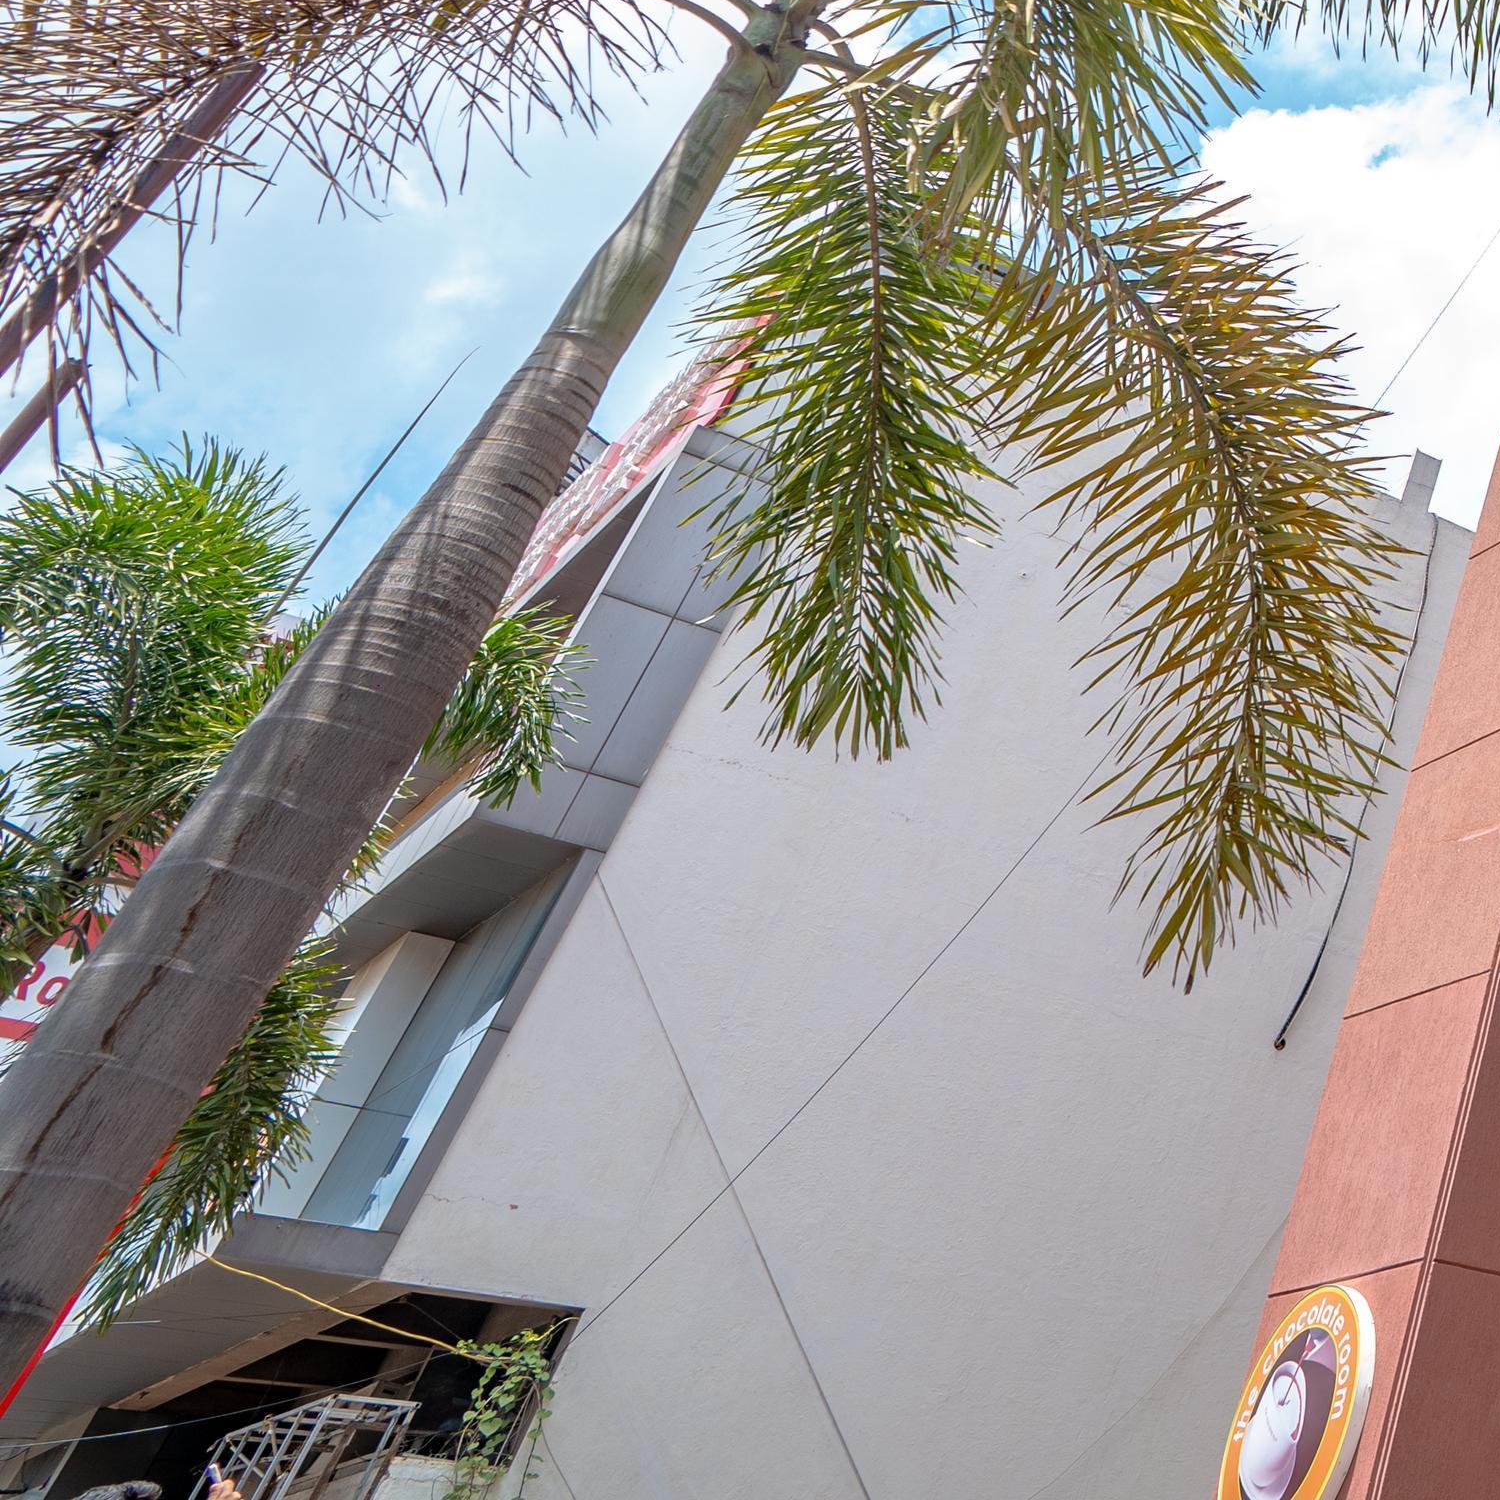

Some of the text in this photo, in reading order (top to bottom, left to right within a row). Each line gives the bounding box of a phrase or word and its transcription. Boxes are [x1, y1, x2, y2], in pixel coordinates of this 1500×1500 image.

[1233, 1385, 1259, 1443] the
[1262, 1297, 1345, 1376] chocolate
[1330, 1333, 1351, 1421] room
